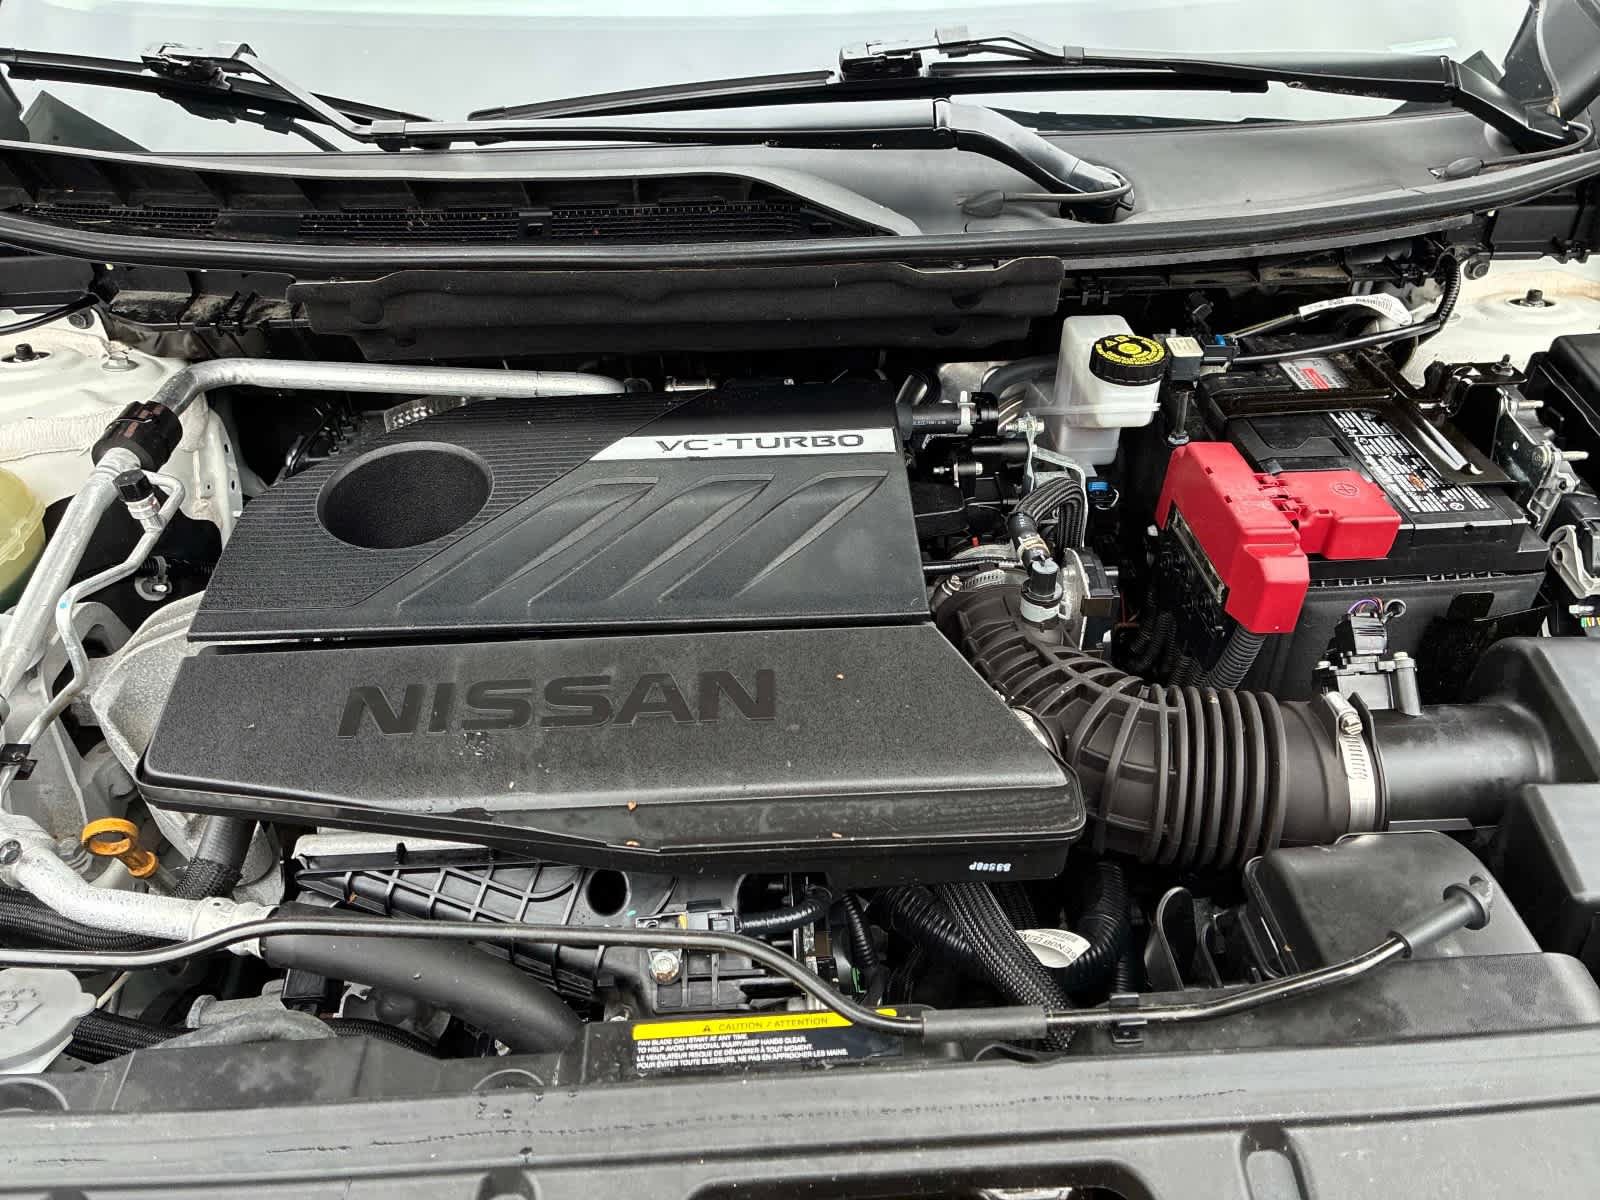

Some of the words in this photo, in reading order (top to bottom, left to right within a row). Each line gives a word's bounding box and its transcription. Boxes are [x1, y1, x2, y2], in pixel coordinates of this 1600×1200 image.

[656, 434, 864, 451] VC-TURBO
[337, 669, 776, 739] NISSAN
[719, 1021, 763, 1031] CAUTION
[774, 1016, 828, 1027] ATTENTION
[686, 1043, 720, 1051] PERSONAL
[762, 1052, 771, 1060] EN
[772, 1051, 813, 1060] APPROCHER
[814, 1050, 825, 1058] LES
